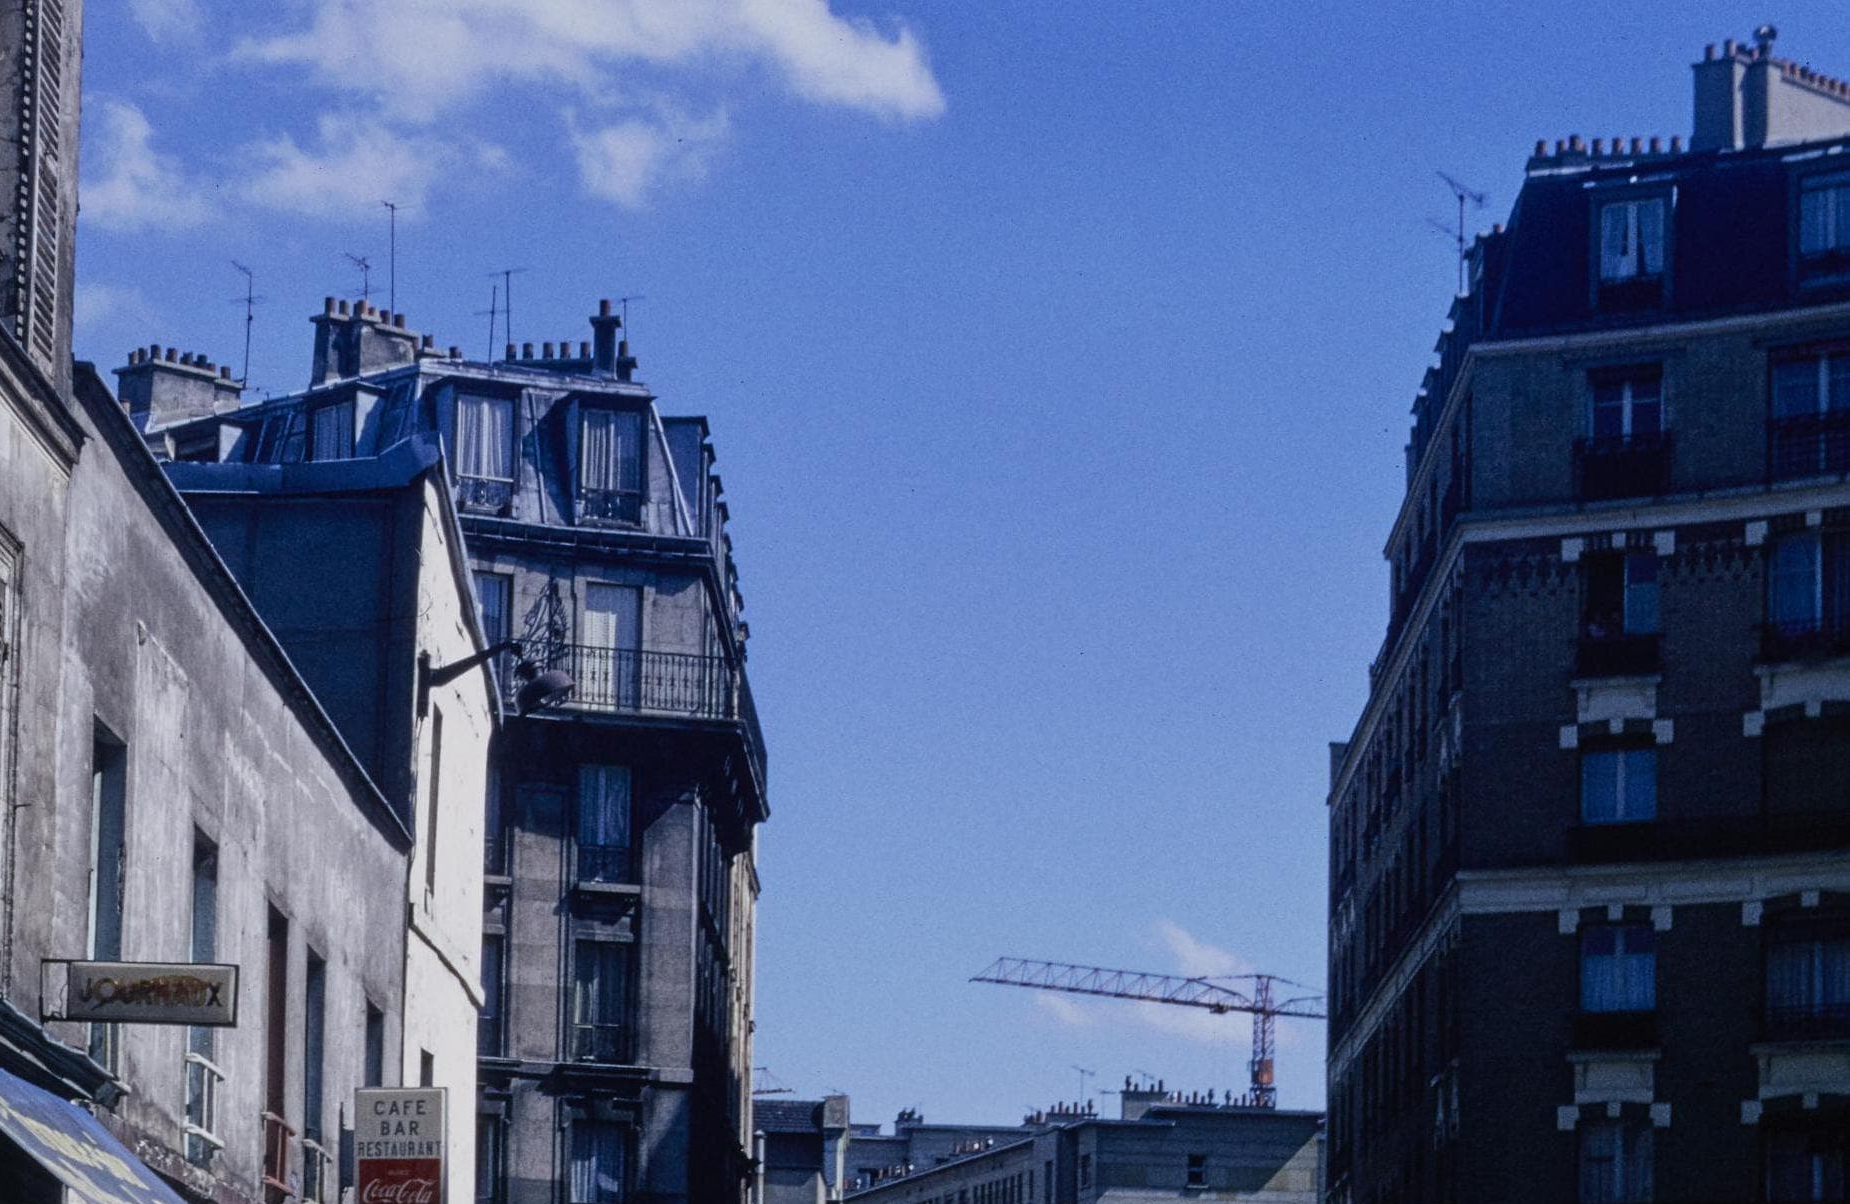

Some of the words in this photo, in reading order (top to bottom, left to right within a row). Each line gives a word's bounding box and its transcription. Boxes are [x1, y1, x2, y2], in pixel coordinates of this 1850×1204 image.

[374, 1100, 431, 1116] CAFE
[380, 1121, 419, 1136] BAR
[358, 1141, 441, 1158] RESTAURANT
[363, 1177, 439, 1204] Coca-Cola
